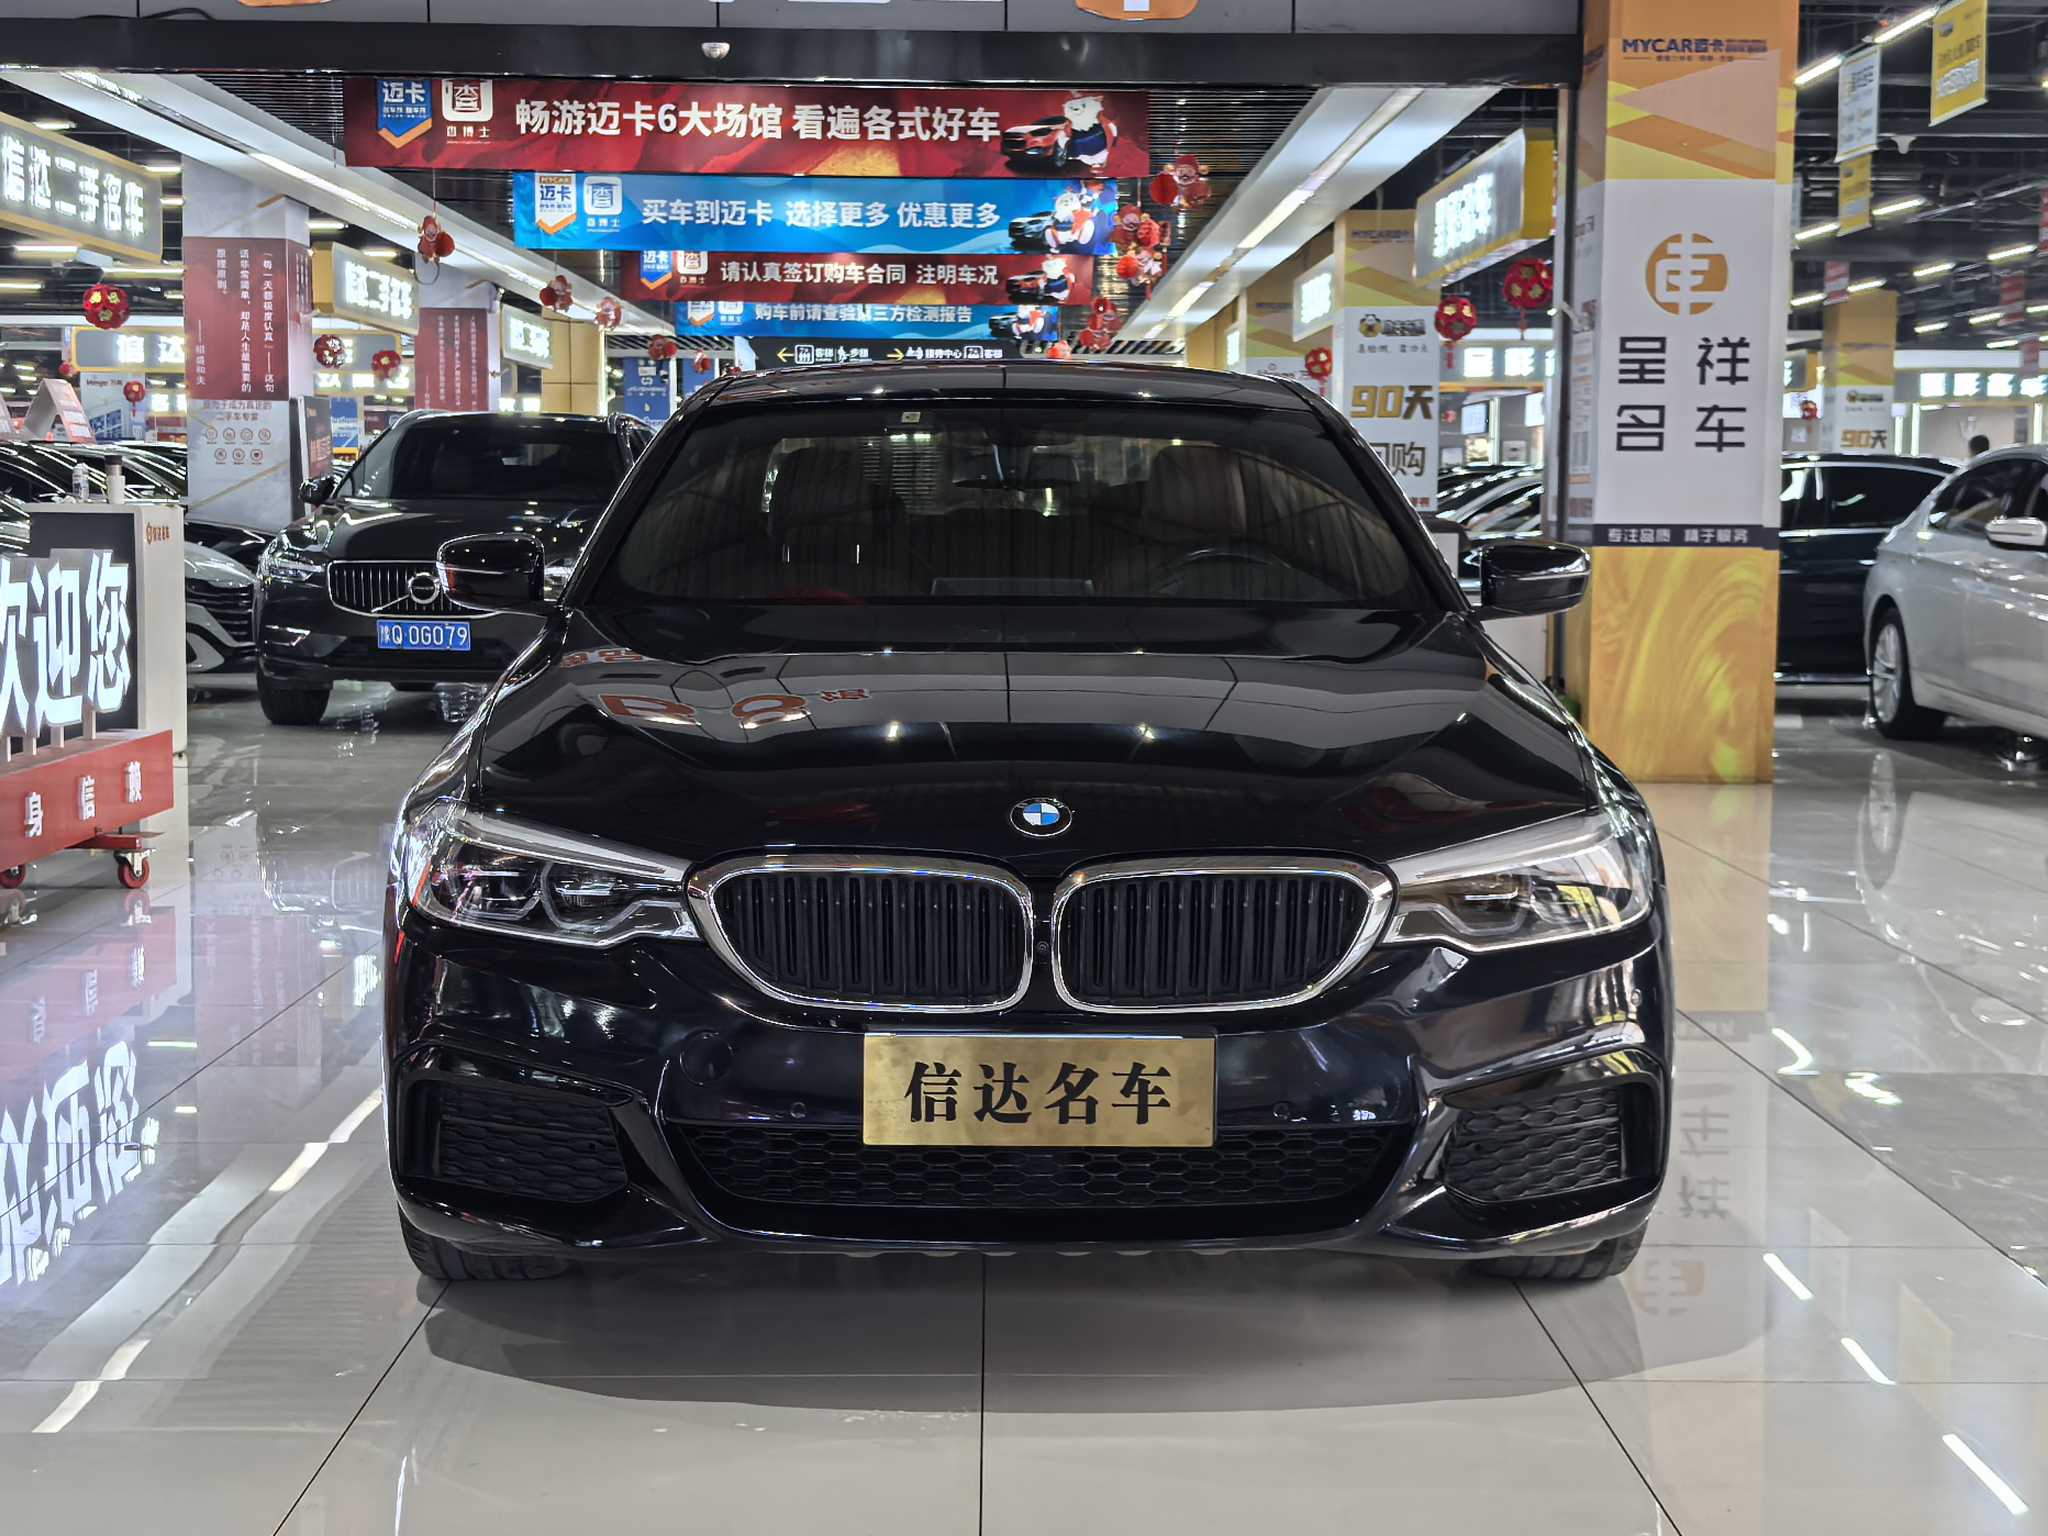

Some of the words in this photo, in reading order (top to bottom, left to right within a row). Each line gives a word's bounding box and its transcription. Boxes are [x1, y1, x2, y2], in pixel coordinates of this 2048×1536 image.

[383, 81, 426, 104] 迈卡
[516, 98, 783, 140] 畅游迈卡6大场馆
[792, 105, 1000, 142] 看遍各式好车
[540, 185, 571, 202] 迈卡
[642, 199, 773, 226] 买车到迈卡
[785, 201, 889, 228] 选择更多
[897, 202, 1000, 229] 优惠更多
[720, 261, 906, 285] 请认真签订购车合同
[917, 263, 998, 285] 注明车况
[1618, 336, 1749, 386] 呈祥
[1351, 385, 1434, 420] 90天
[1616, 404, 1747, 452] 名车
[904, 1062, 1172, 1125] 信达名车
